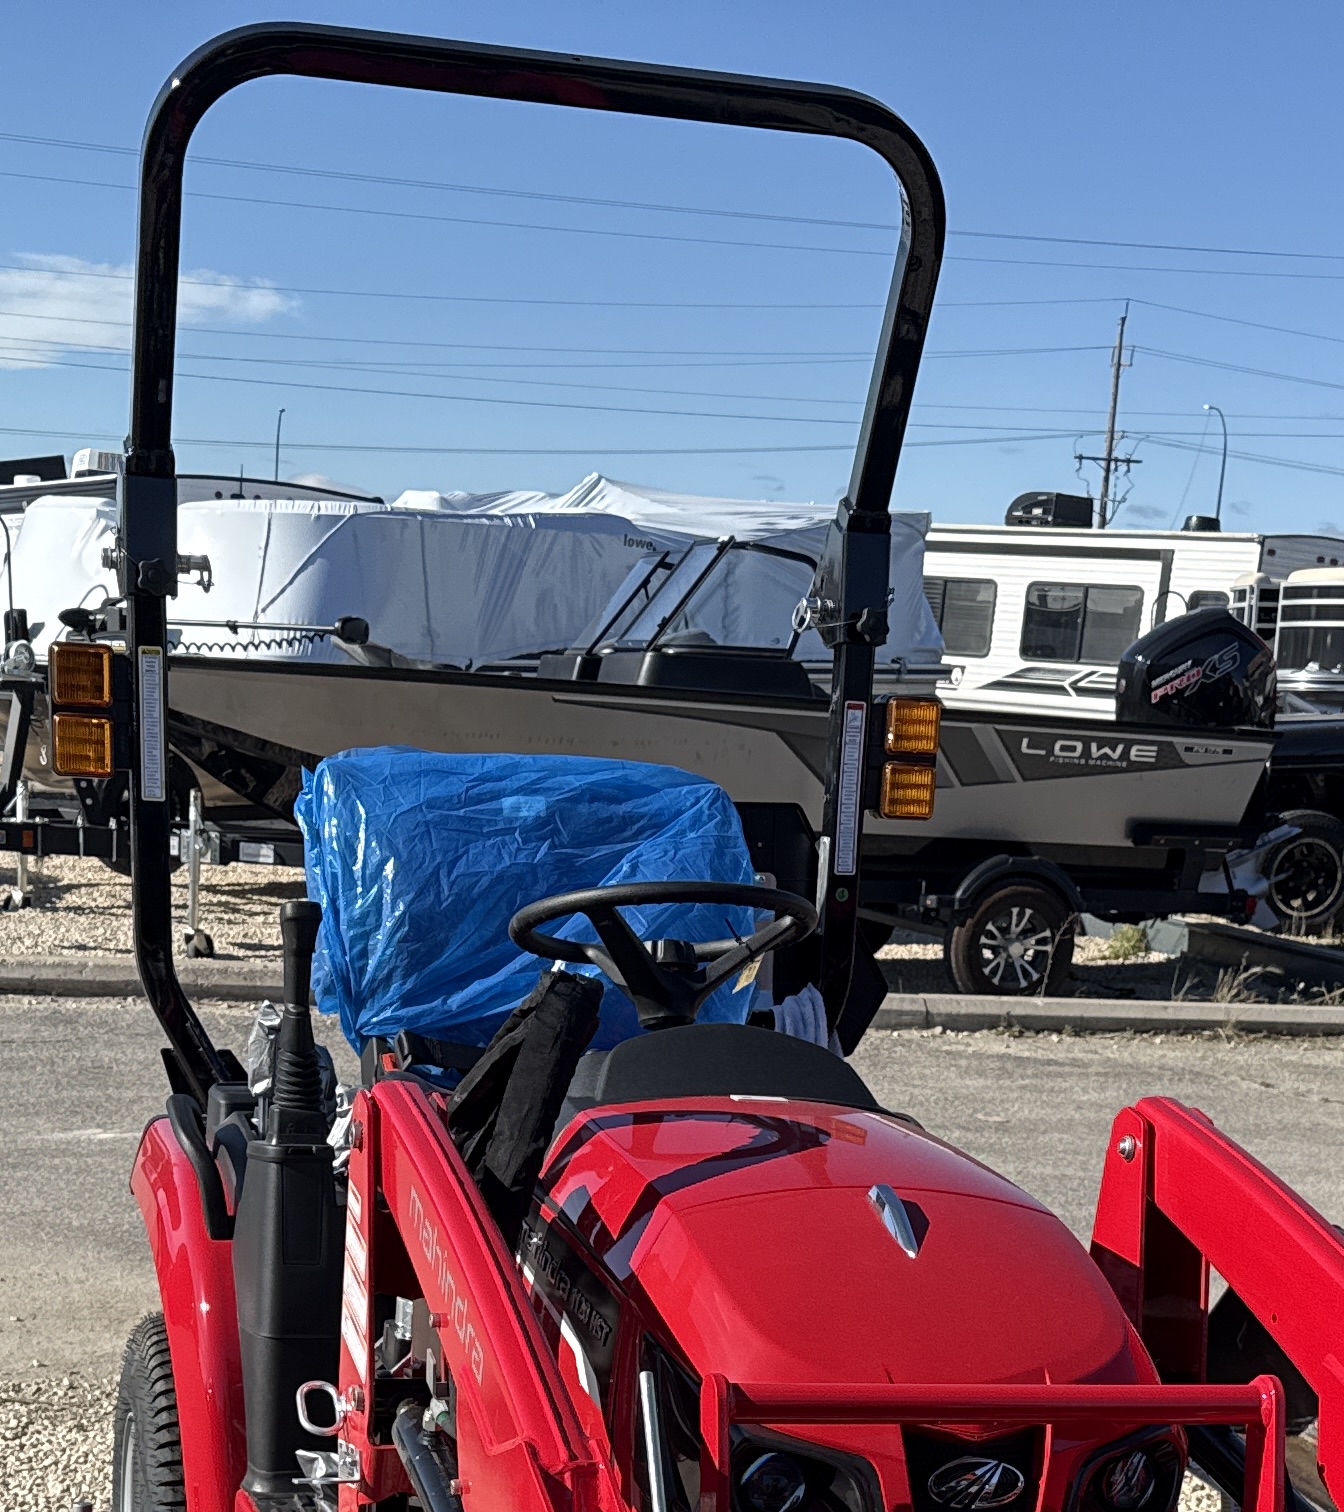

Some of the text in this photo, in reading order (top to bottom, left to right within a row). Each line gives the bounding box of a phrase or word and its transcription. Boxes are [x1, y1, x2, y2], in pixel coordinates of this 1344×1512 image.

[1020, 737, 1158, 763] LOWE
[1088, 758, 1128, 768] MACHINE
[409, 1184, 484, 1387] mahindra
